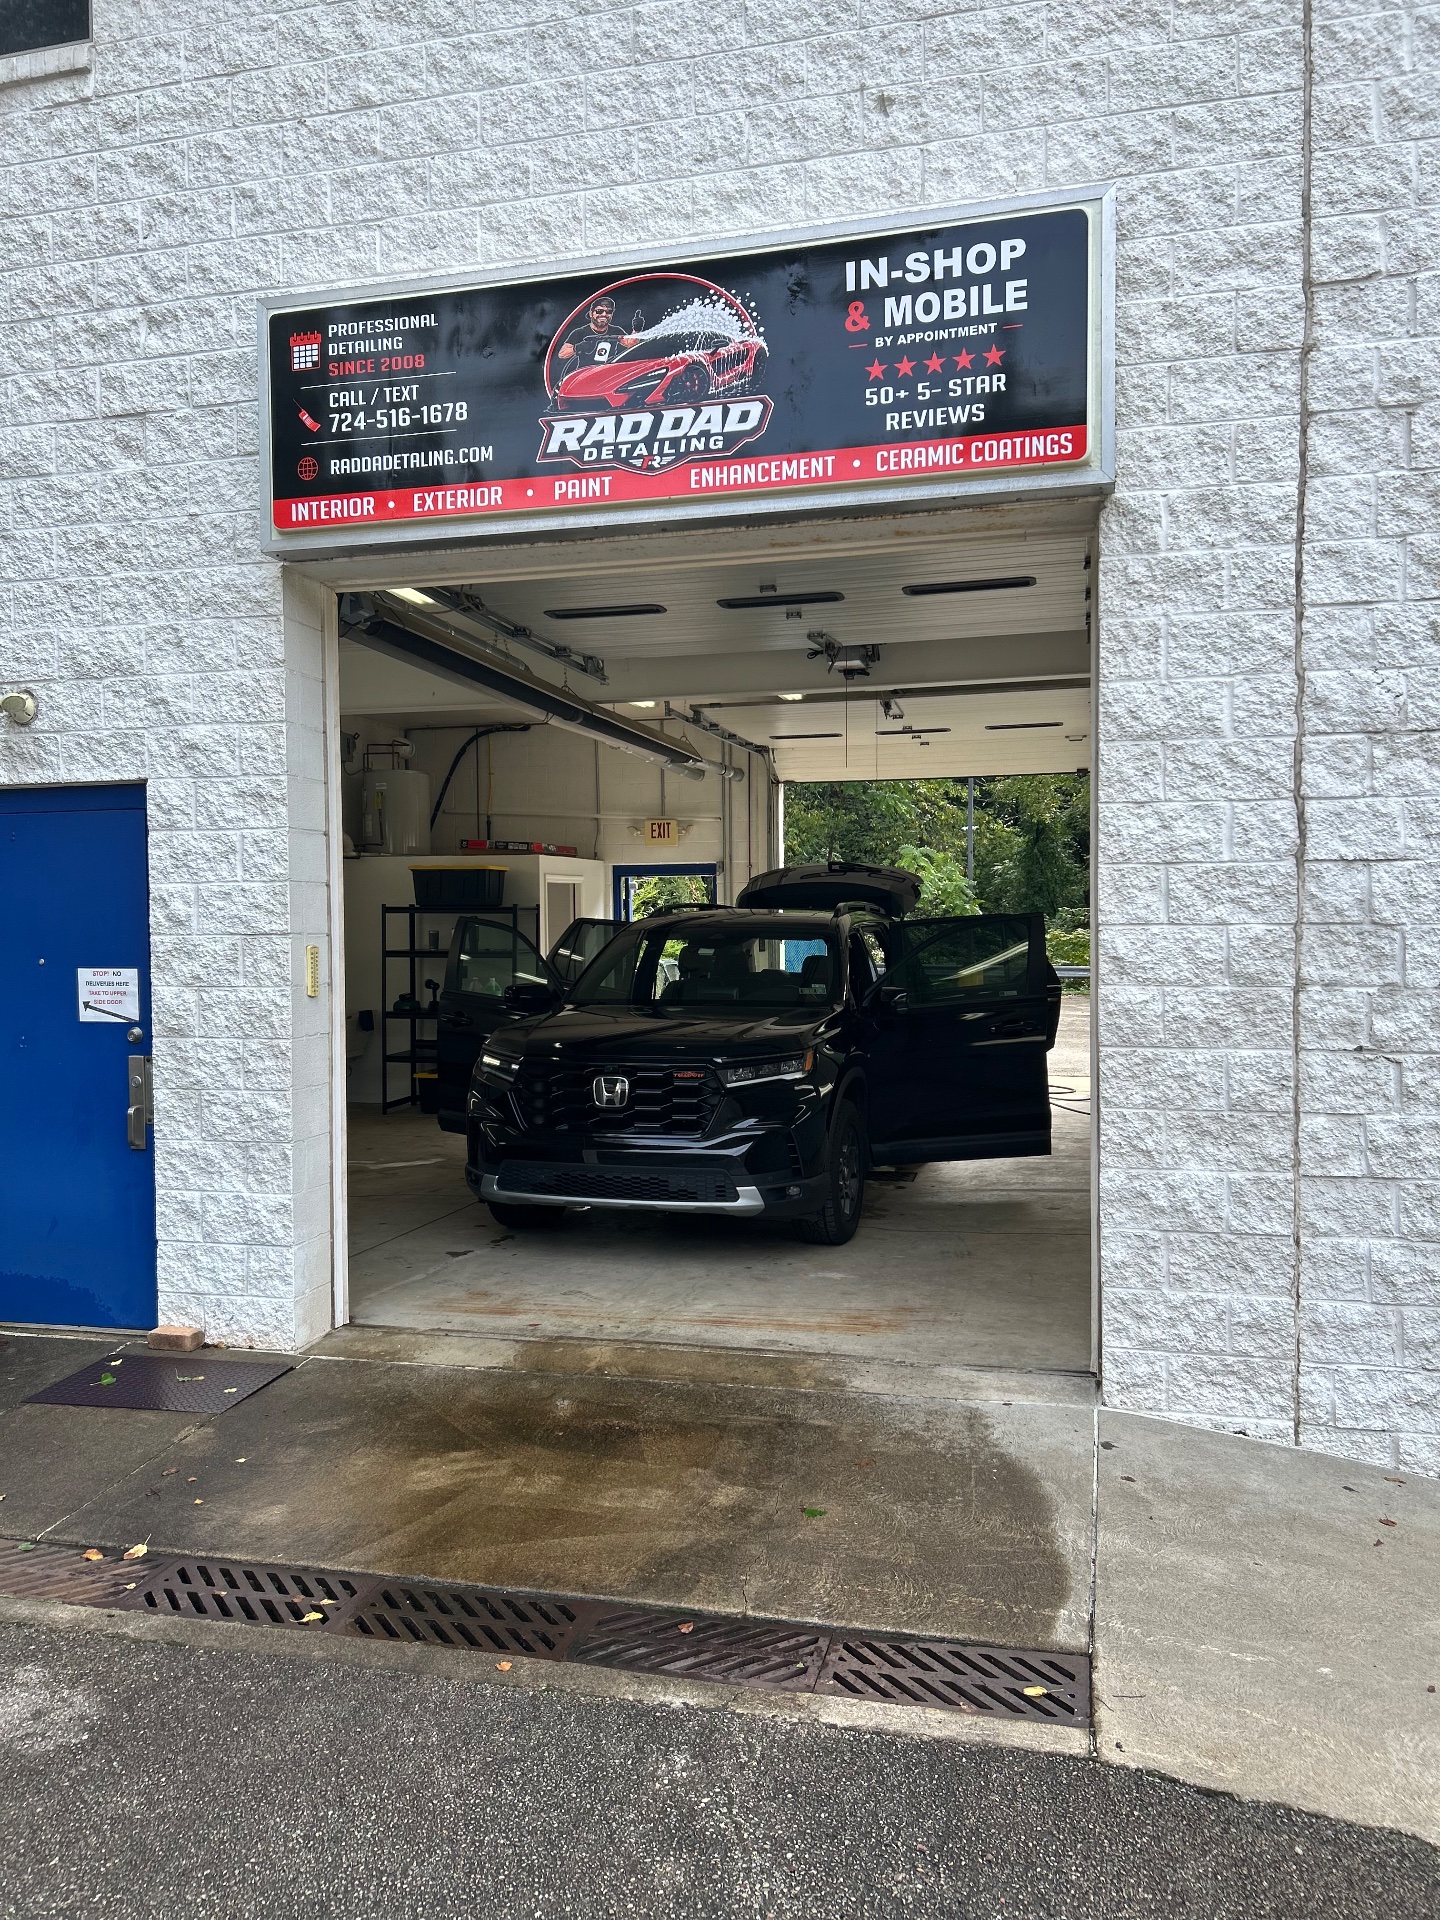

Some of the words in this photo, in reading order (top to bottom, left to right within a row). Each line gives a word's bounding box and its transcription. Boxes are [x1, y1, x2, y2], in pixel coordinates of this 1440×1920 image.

[845, 238, 1027, 292] IN-SHOP
[844, 300, 871, 332] &
[884, 278, 1028, 328] MOBILE
[328, 313, 438, 338] PROFESSIONAL
[875, 335, 893, 348] BY
[897, 322, 997, 346] APPOINTMENT
[328, 336, 403, 356] DETAILING
[328, 358, 376, 376] SINCE
[381, 354, 425, 371] 2008
[329, 390, 366, 408] CALL
[370, 388, 379, 406] /
[384, 384, 419, 403] TEXT
[865, 386, 909, 406] 50+
[917, 381, 942, 401] 5-
[948, 373, 1006, 397] STAR
[328, 401, 468, 433] 724-516-1678
[546, 411, 655, 453] RAD
[656, 400, 764, 440] DAD
[885, 403, 985, 431] REVIEWS
[330, 446, 493, 475] RADDADETALING.COM
[583, 435, 724, 462] DETAILING
[291, 497, 375, 522] INTERIOR
[413, 486, 503, 512] EXTERIOR
[554, 476, 613, 500] PAINT
[690, 455, 836, 489] ENHANCEMENT
[876, 443, 964, 472] CERAMIC
[970, 433, 1073, 462] COATINGS
[651, 822, 671, 839] EXIT
